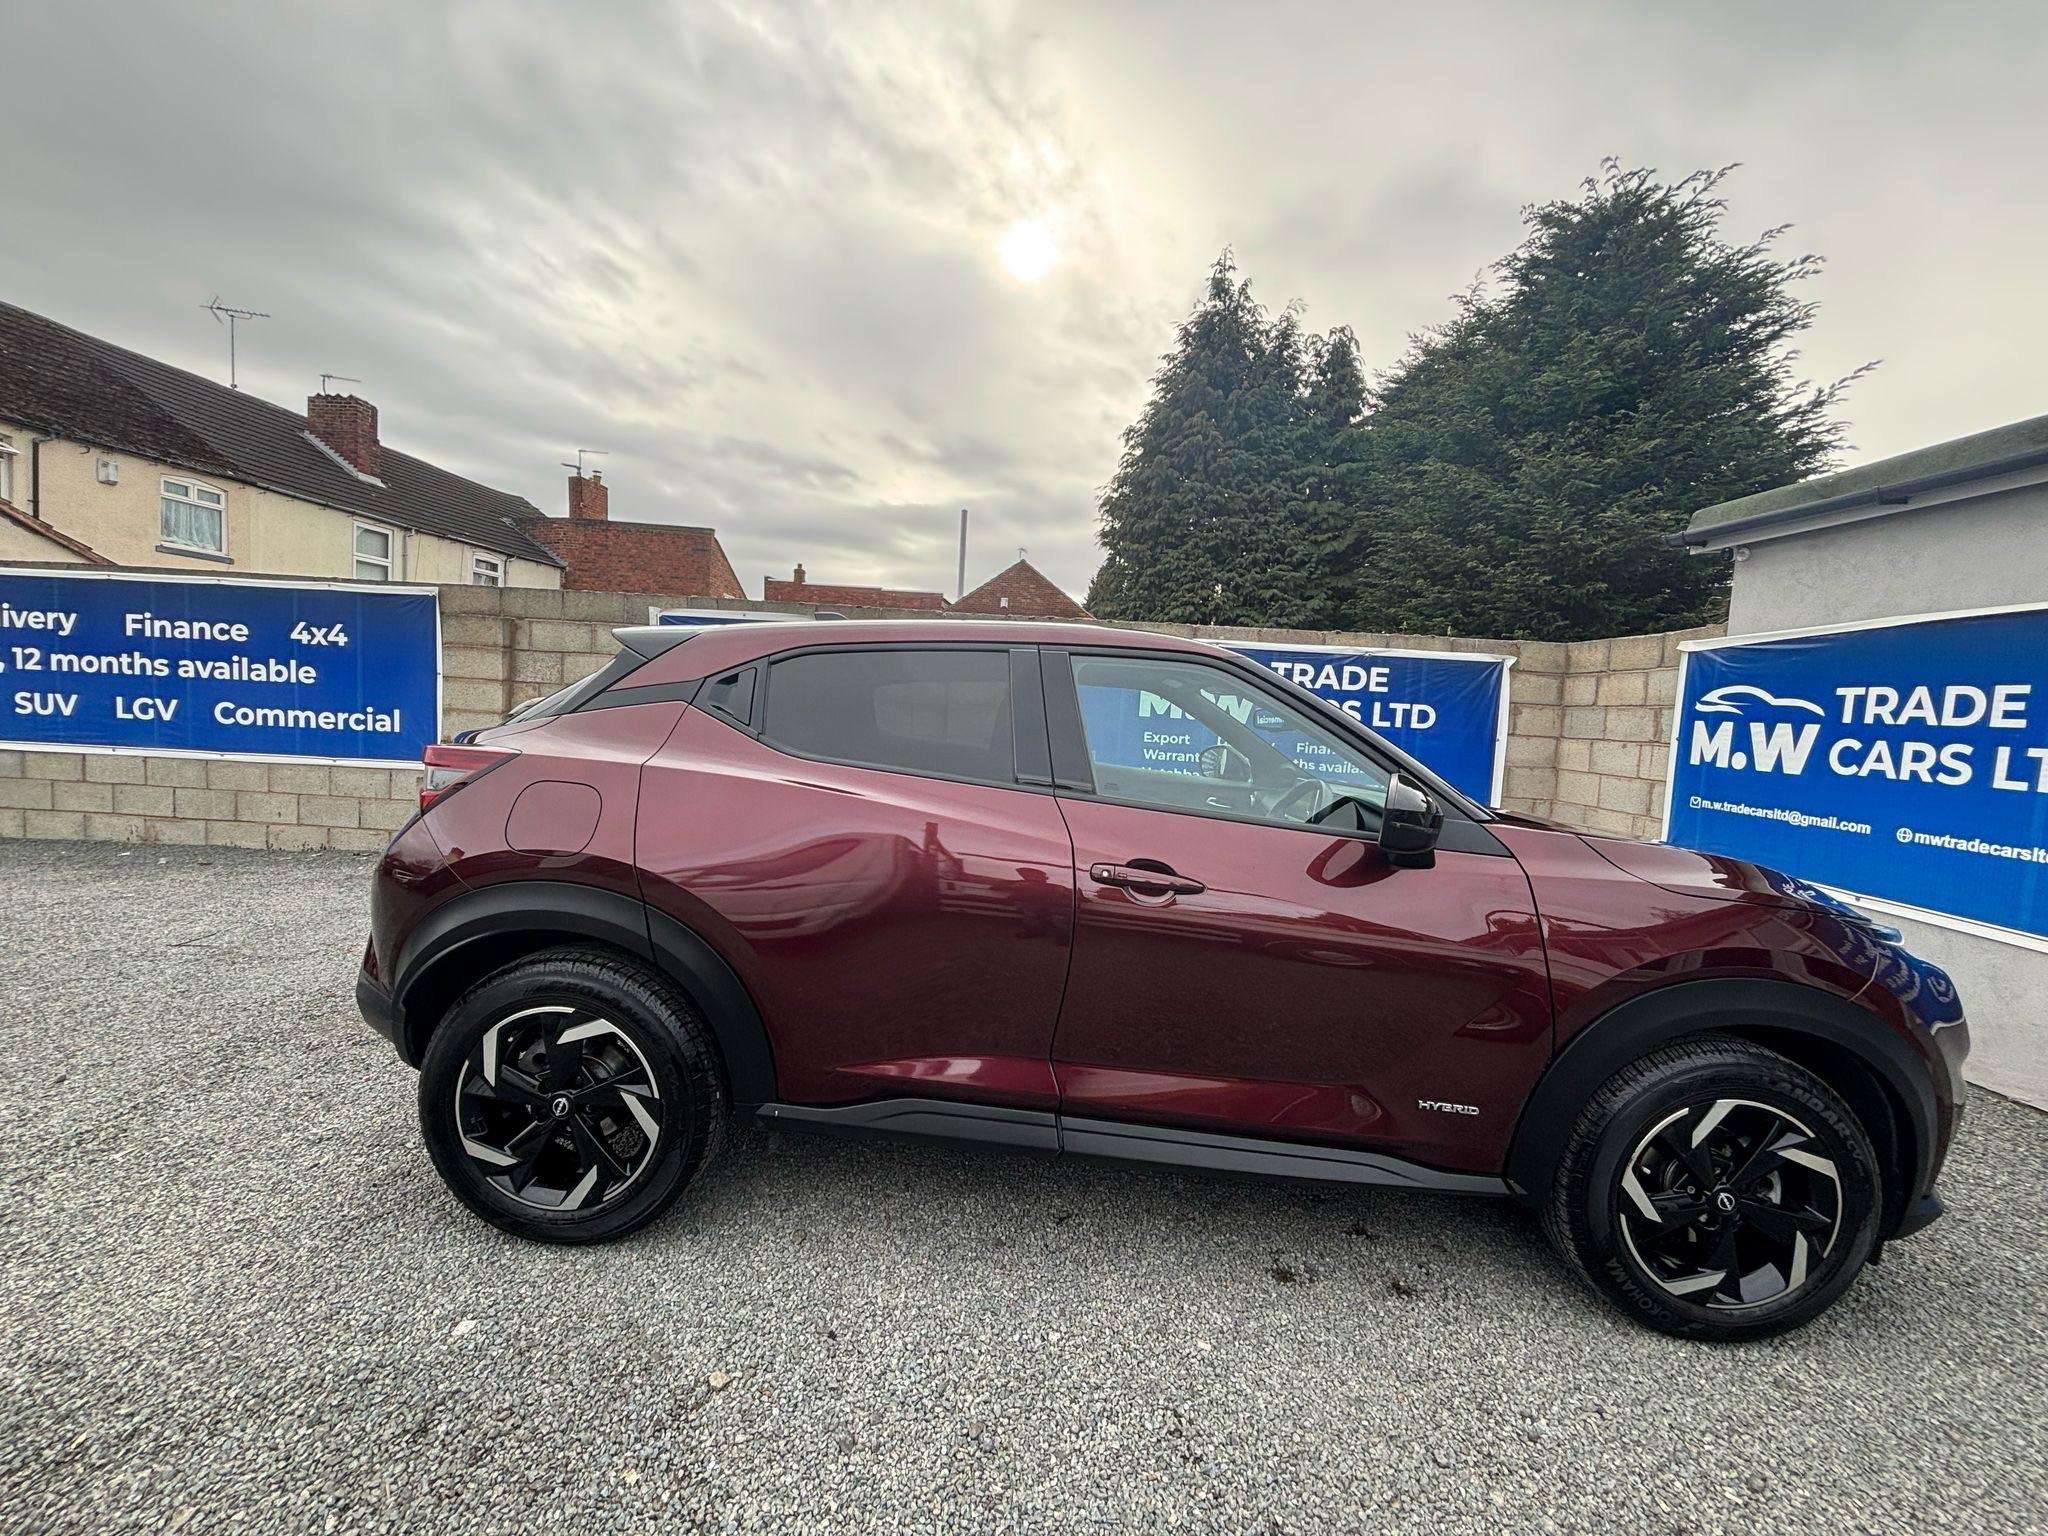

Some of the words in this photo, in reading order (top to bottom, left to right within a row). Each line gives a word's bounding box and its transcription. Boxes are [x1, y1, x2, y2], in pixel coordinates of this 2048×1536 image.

[0, 602, 78, 636] ivery
[125, 612, 249, 642] Finance
[290, 621, 349, 647] 4x4
[11, 646, 42, 671] 12
[50, 651, 170, 677] months
[177, 655, 317, 684] available
[1270, 661, 1390, 693] TRADE
[14, 691, 78, 716] SUV
[115, 696, 178, 721] LGV
[213, 701, 400, 733] Commercial
[1372, 701, 1437, 730] LTD
[1836, 684, 2032, 729] TRADE
[1143, 731, 1191, 746] Export
[1143, 748, 1201, 764] Warrant
[1689, 720, 1821, 775] M.W
[1828, 738, 1974, 786] CARS
[1992, 746, 2048, 794] LT
[1701, 799, 1872, 835] m.w.tradecarsltd@gmail.com
[1418, 1099, 1480, 1115] HYBRID
[1604, 1256, 1676, 1323] OKOHAMA
